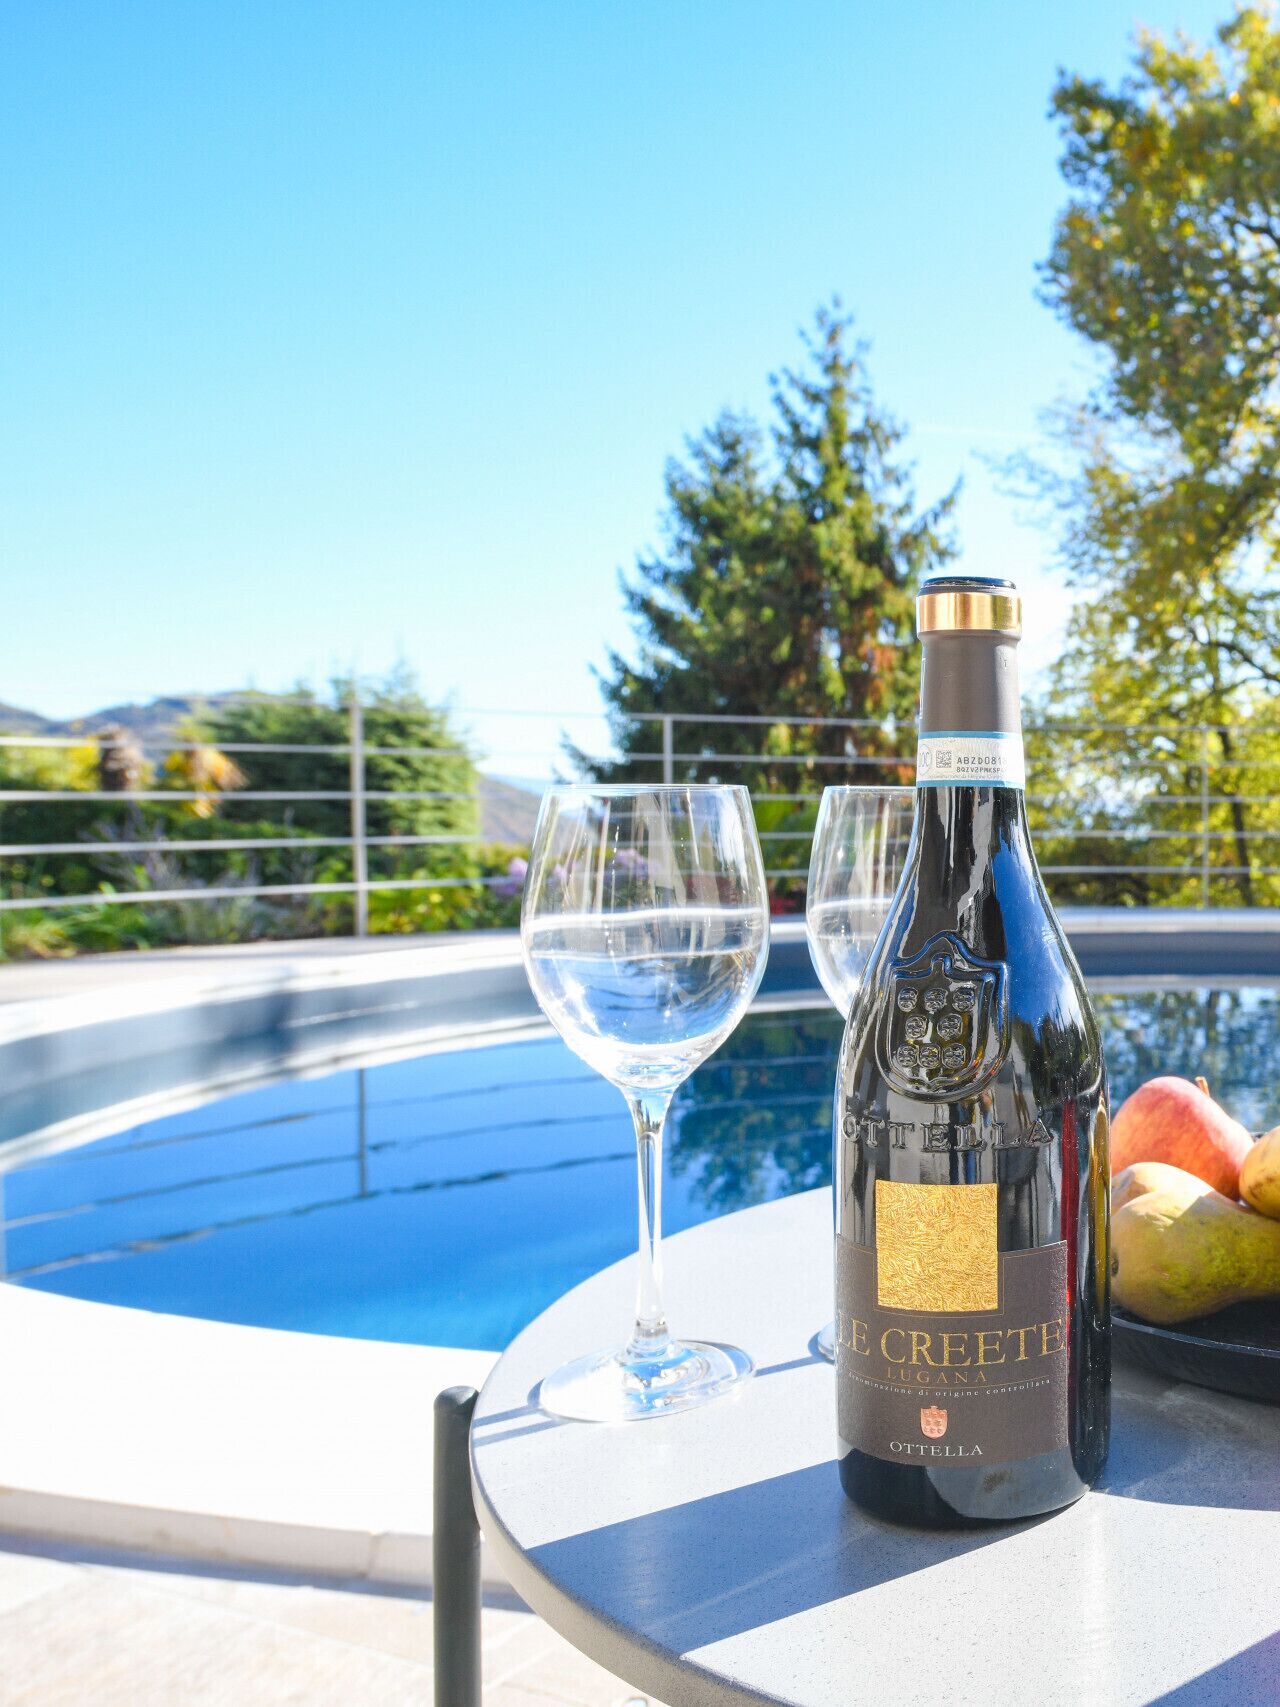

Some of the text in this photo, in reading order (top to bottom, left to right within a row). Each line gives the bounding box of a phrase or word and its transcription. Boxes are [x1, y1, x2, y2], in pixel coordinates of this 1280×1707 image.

[839, 1312, 1067, 1367] LE CREETE
[887, 1367, 988, 1384] LUGANA
[918, 1388, 929, 1396] di
[935, 1389, 979, 1398] origine
[986, 1378, 1051, 1395] controllata
[889, 1441, 984, 1457] OTTELLA
